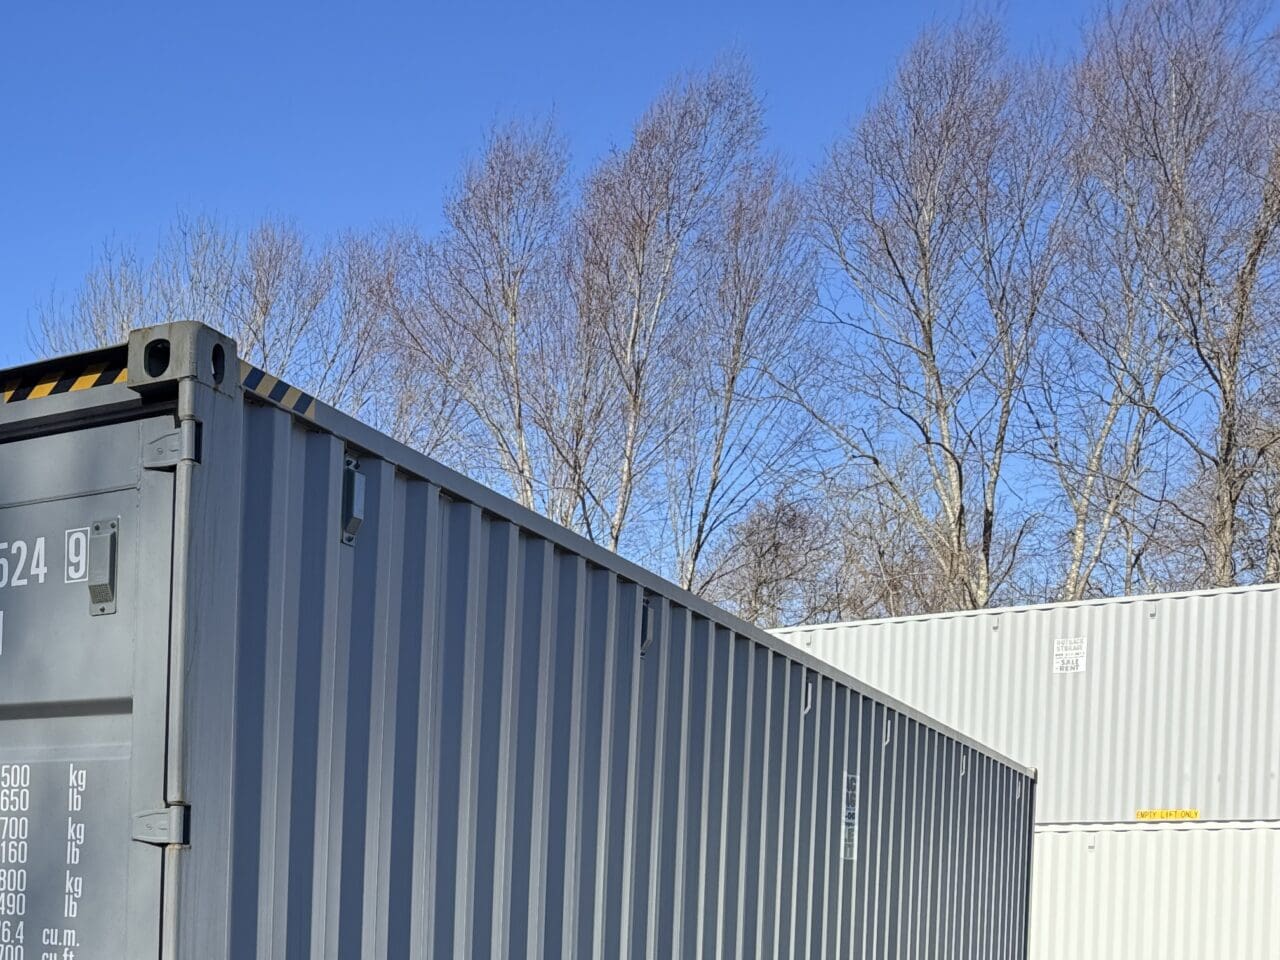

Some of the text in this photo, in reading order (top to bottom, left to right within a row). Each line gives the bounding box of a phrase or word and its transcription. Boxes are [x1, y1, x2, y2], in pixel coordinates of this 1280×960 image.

[68, 531, 87, 579] 9
[69, 763, 87, 792] kg
[68, 787, 82, 812] lb
[67, 816, 85, 845] kg
[66, 841, 80, 865] lb
[65, 870, 83, 898] kg
[64, 894, 78, 918] lb
[42, 927, 80, 947] cu.m.
